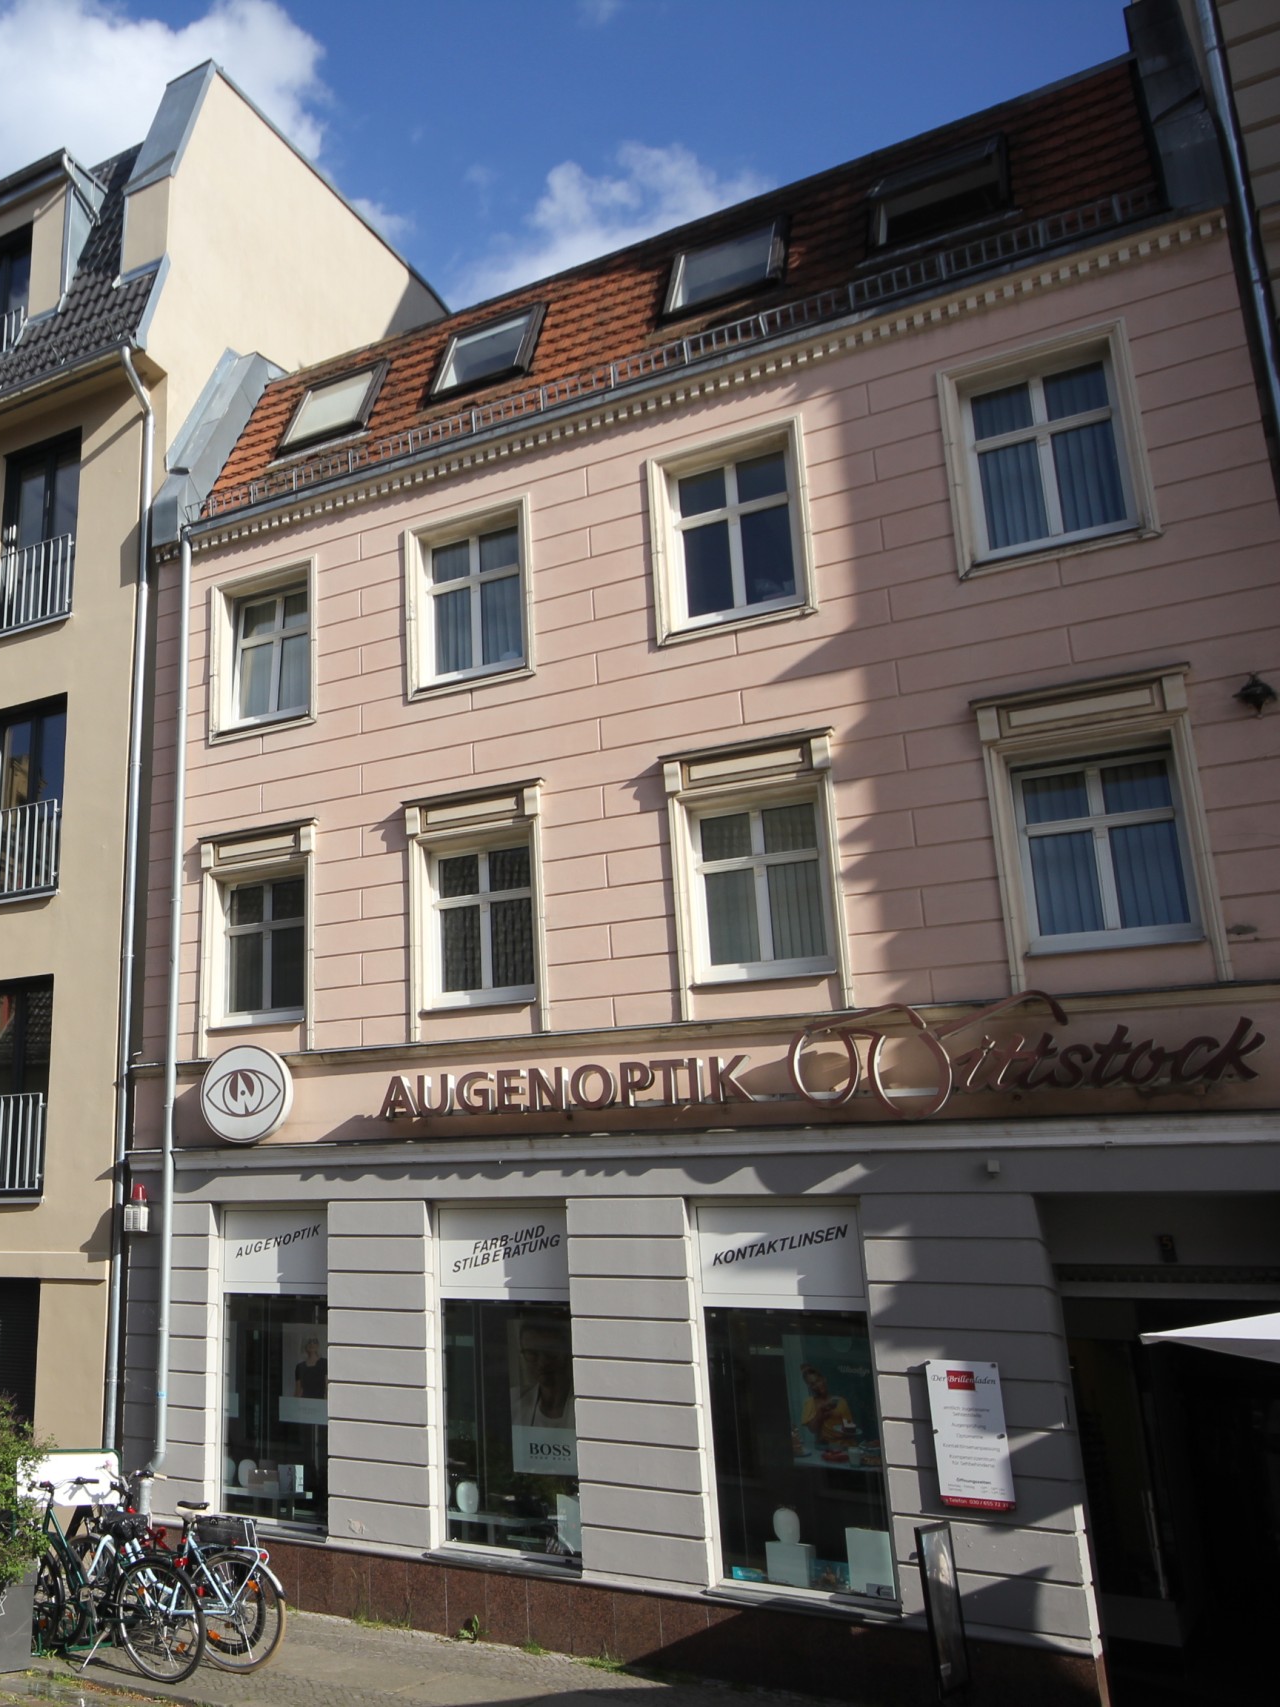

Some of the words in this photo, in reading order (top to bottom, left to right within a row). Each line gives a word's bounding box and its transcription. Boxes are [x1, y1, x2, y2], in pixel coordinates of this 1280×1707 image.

[380, 1054, 756, 1121] AUGENOPTIK
[235, 1223, 321, 1259] AUGENOPTIK
[451, 1234, 561, 1273] STILBERATUNG
[472, 1224, 545, 1255] FARB-UND
[712, 1223, 849, 1267] KONTAKTLINSEN
[931, 1374, 946, 1382] Der
[947, 1374, 997, 1385] Brillenladen
[529, 1442, 572, 1457] BOSS
